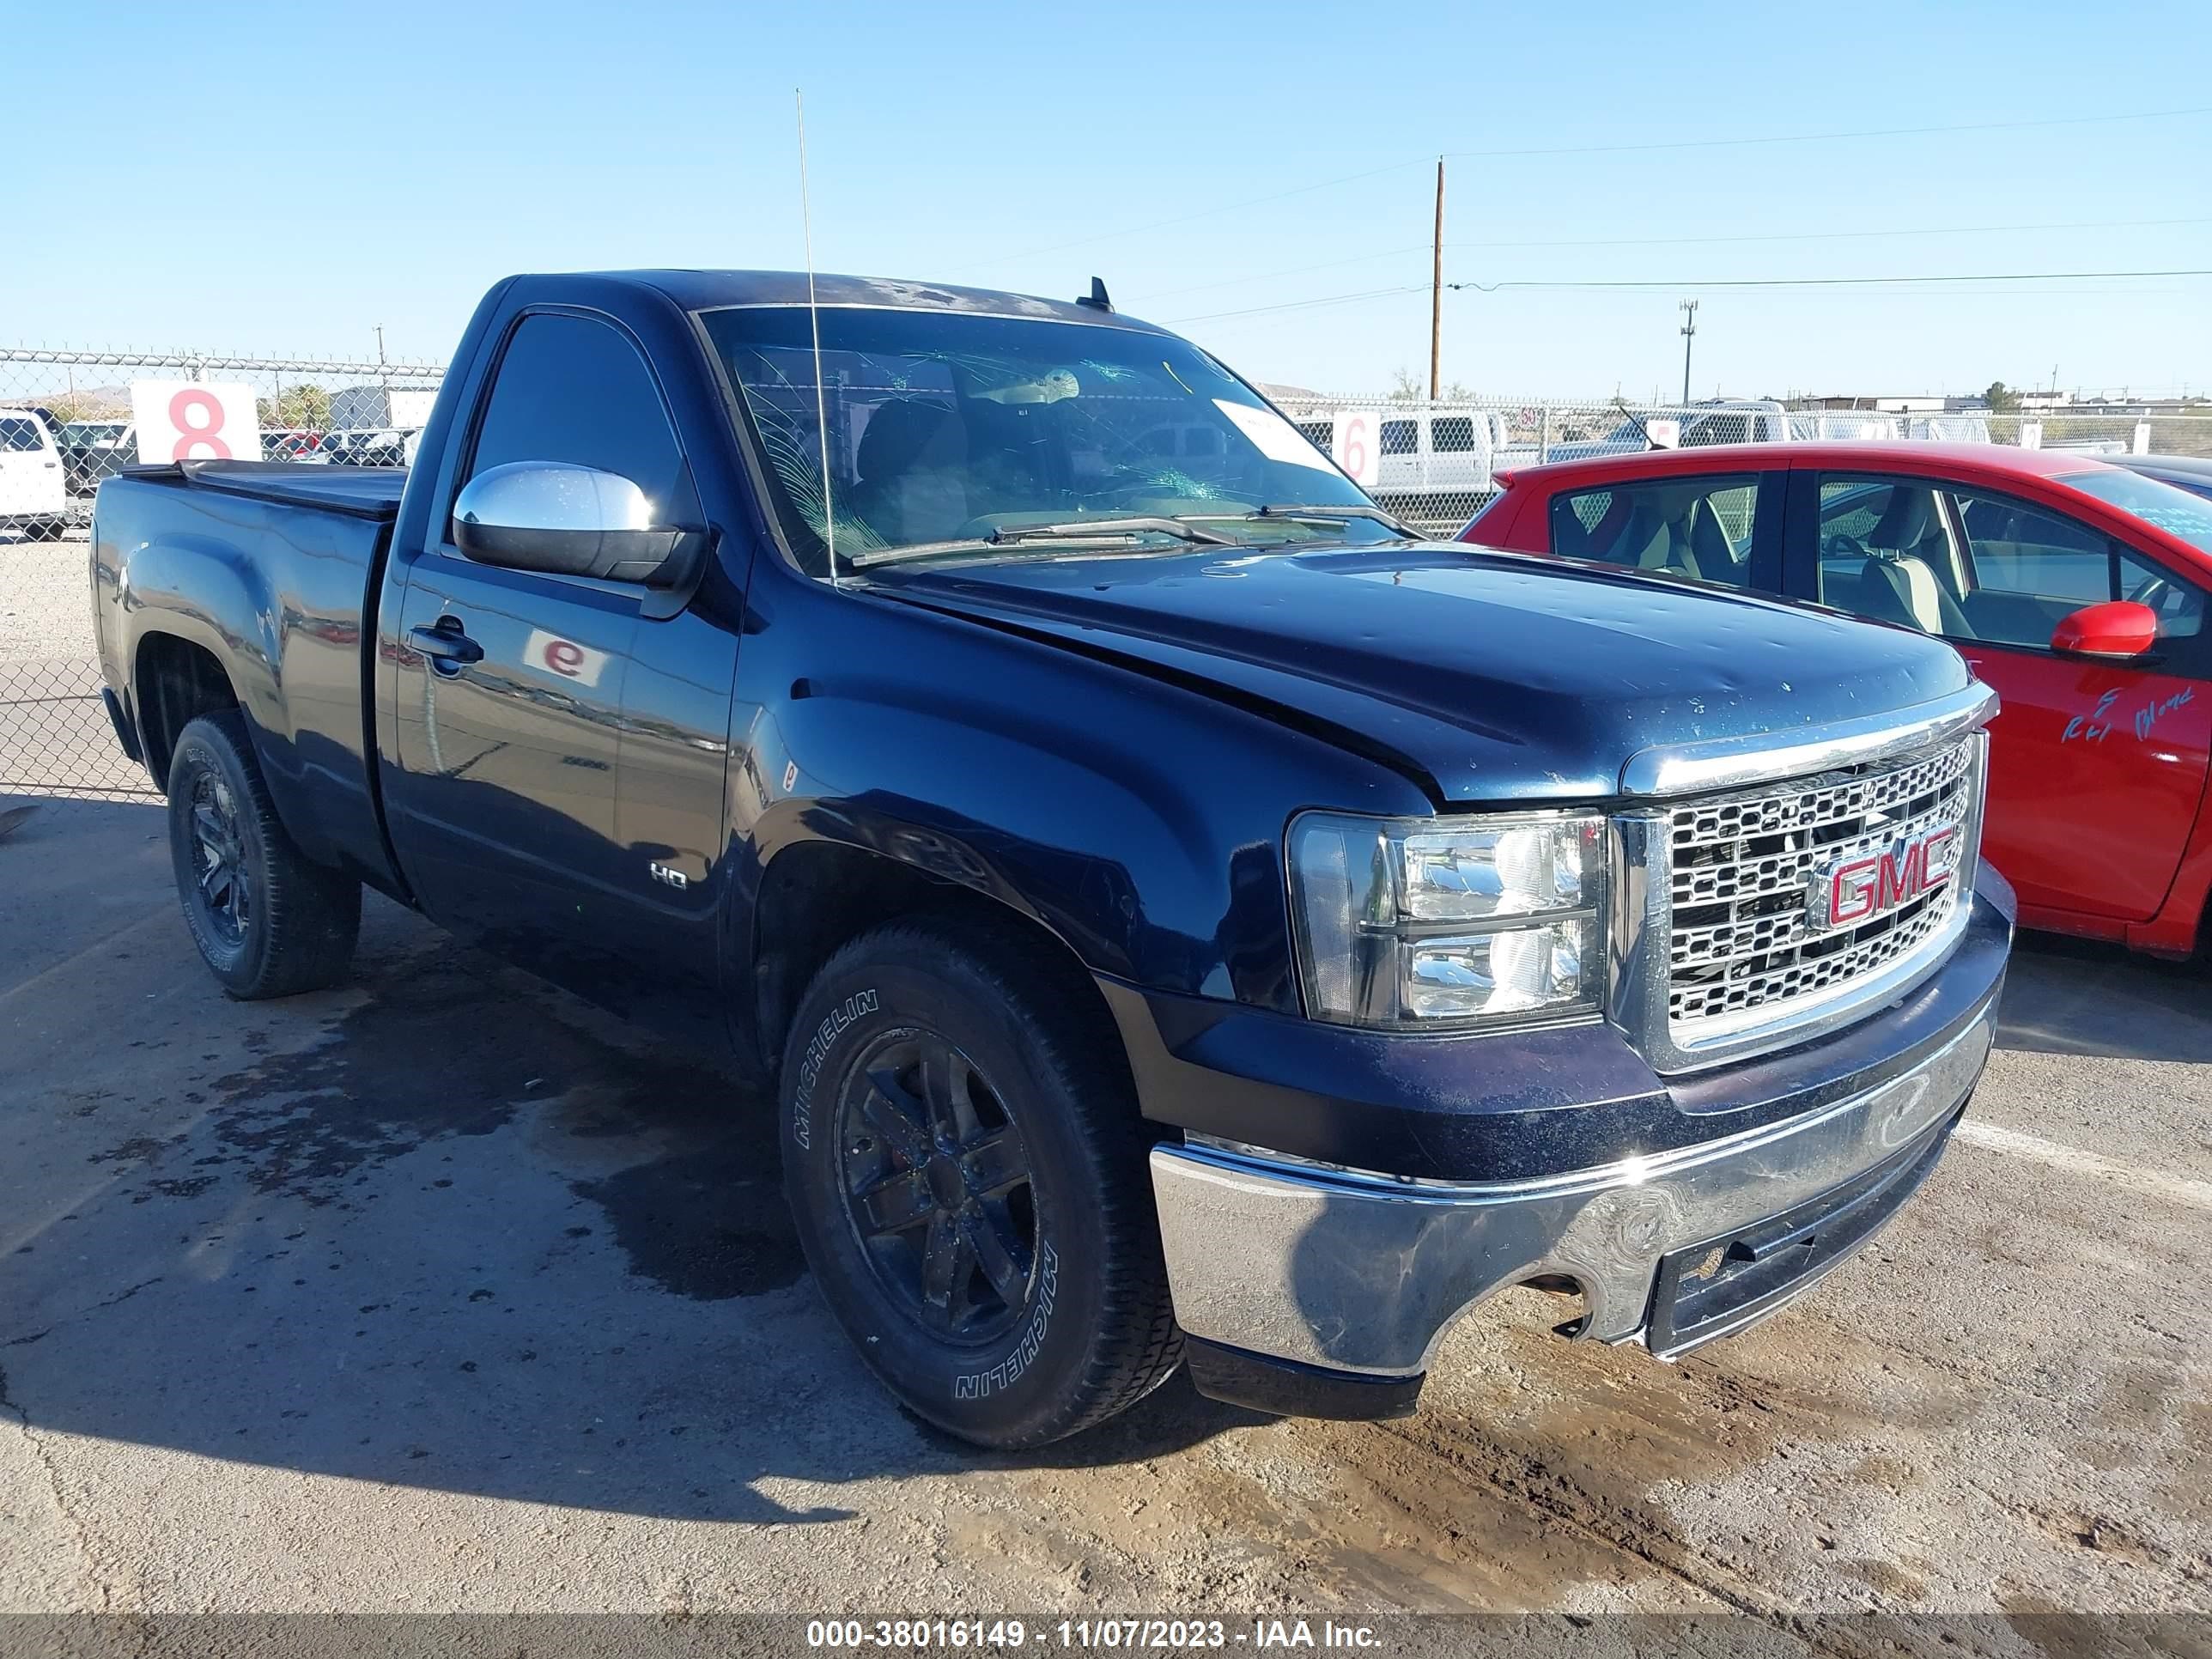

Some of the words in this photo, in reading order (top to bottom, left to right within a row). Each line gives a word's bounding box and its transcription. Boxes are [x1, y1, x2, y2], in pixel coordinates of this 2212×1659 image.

[168, 388, 234, 460] 8
[1343, 418, 1366, 478] 6
[650, 861, 687, 891] HD
[1830, 826, 1953, 926] GMC
[793, 989, 879, 1151] MICHELIN
[955, 1239, 1058, 1399] MICHELIN
